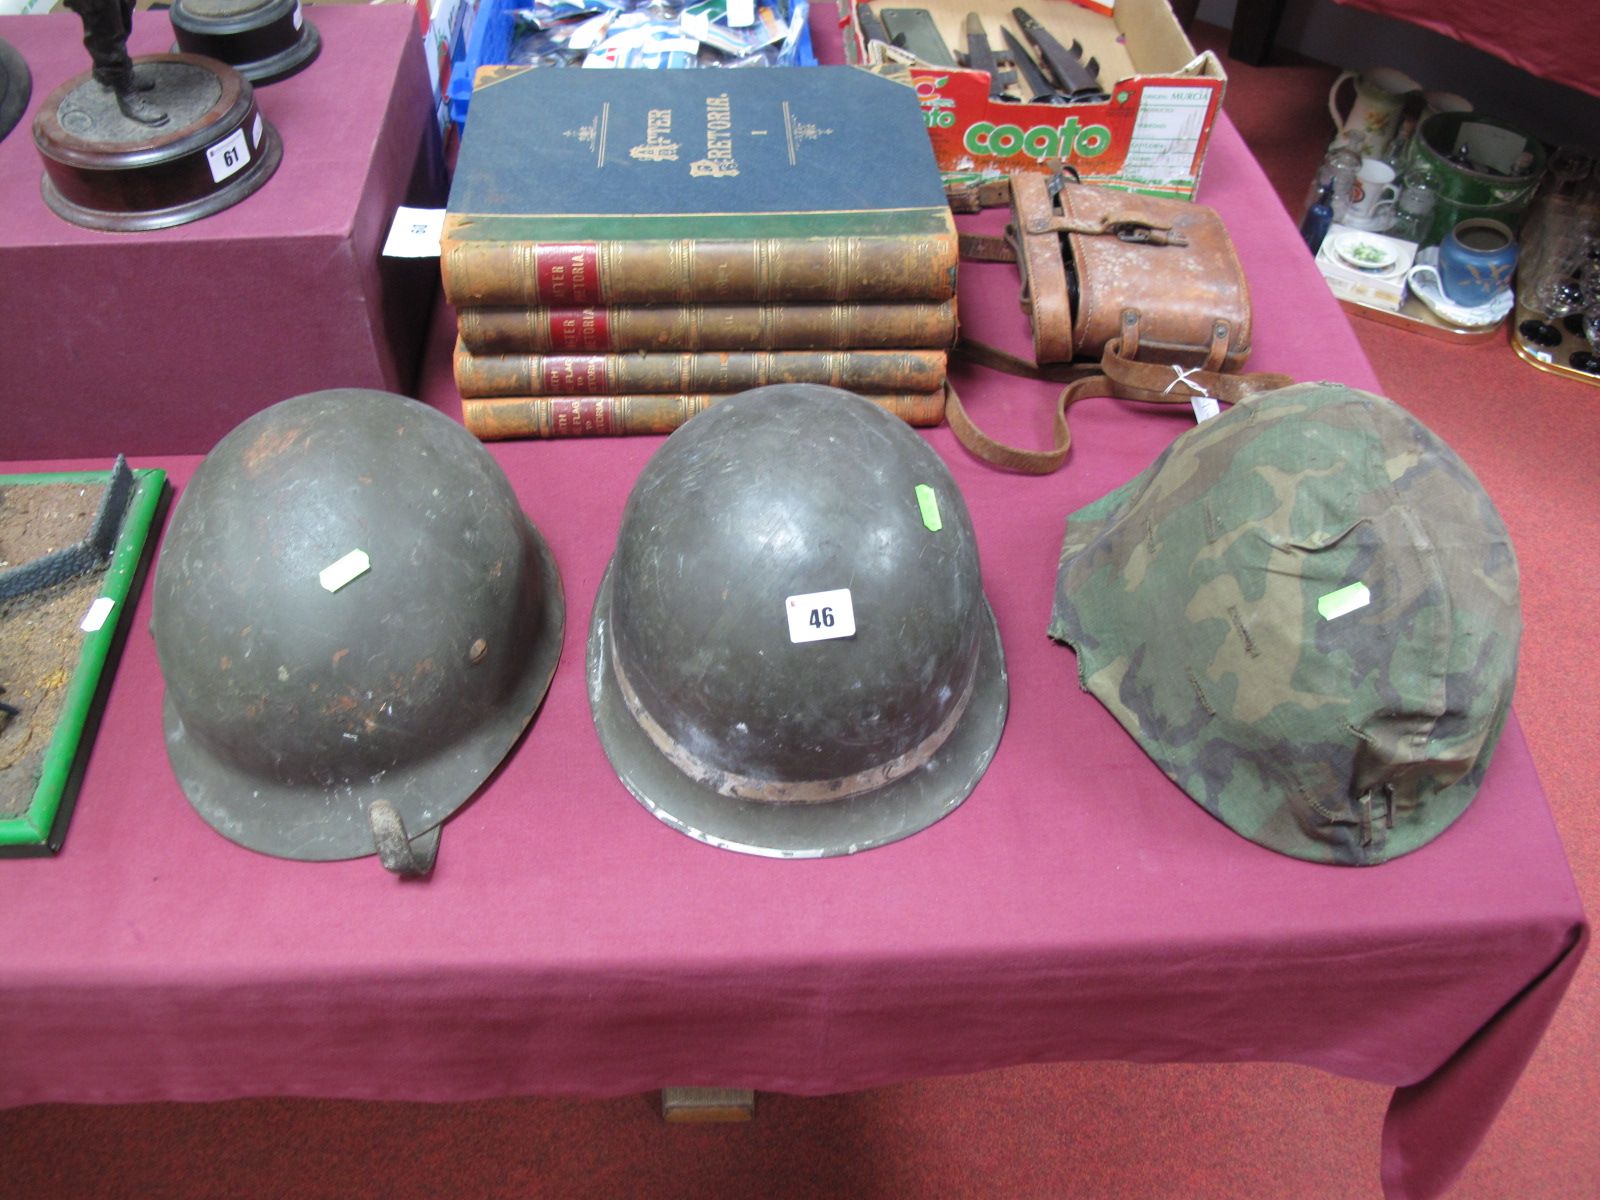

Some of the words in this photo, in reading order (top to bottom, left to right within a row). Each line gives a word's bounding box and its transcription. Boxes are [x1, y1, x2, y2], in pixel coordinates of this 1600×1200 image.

[630, 109, 681, 162] AFTER
[690, 93, 740, 178] PRETORIA.
[963, 116, 1111, 158] coato
[224, 147, 239, 167] 61
[809, 607, 835, 629] 46
